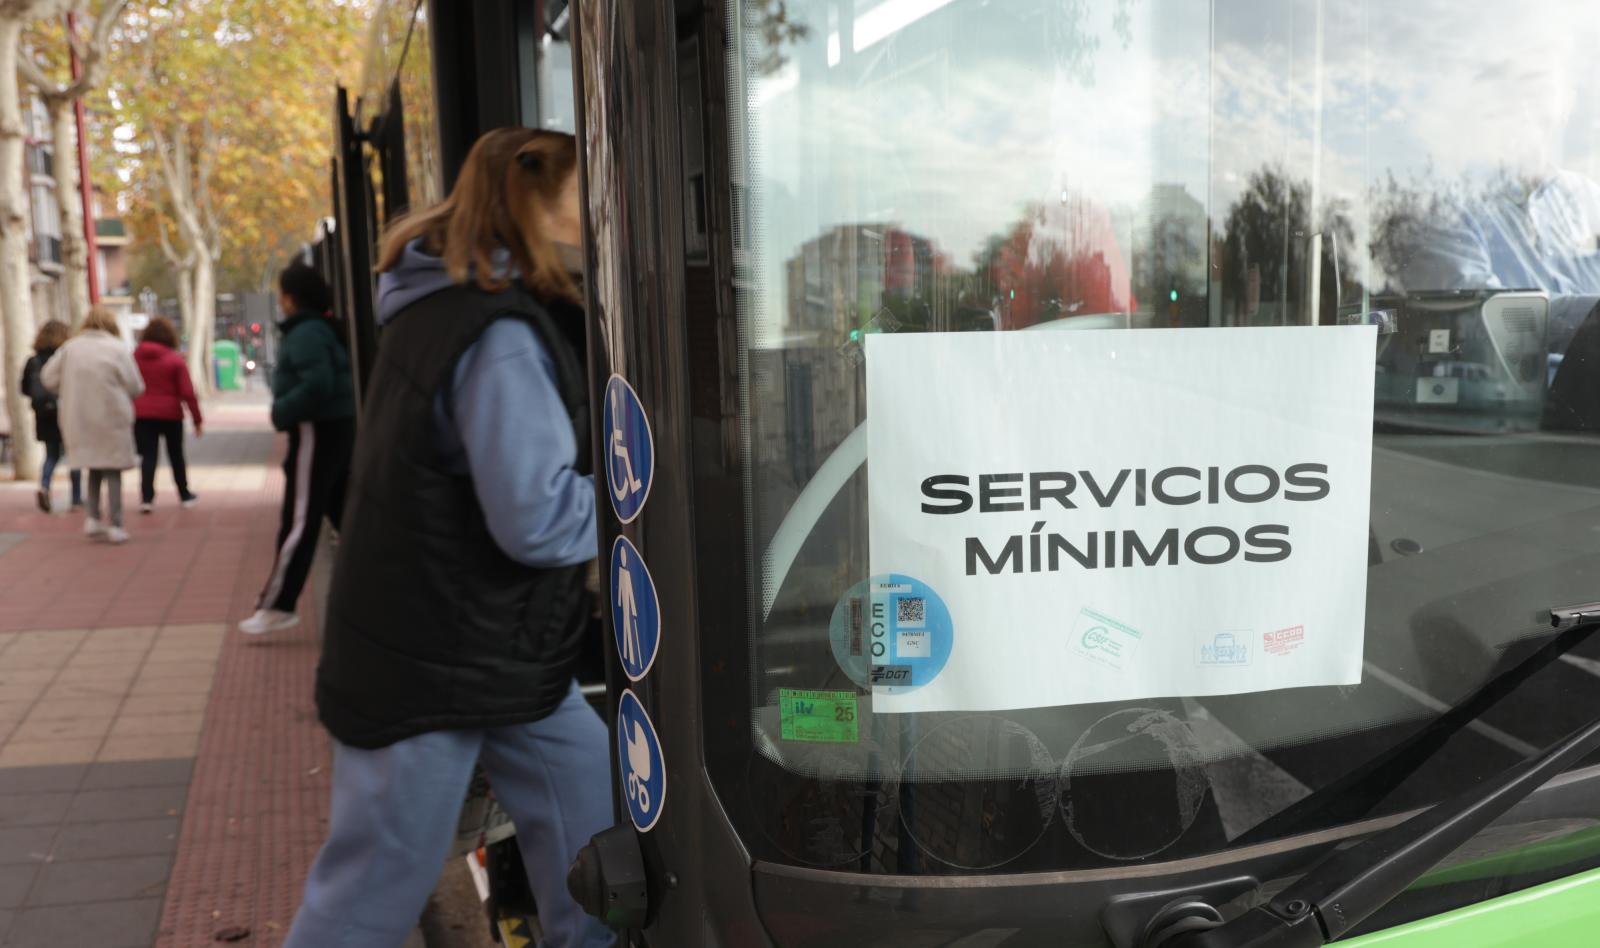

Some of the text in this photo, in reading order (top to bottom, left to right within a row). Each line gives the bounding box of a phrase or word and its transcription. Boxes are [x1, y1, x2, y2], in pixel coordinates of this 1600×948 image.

[920, 463, 1331, 515] SERVICIOS
[965, 521, 1293, 576] MÍNIMOS
[871, 603, 885, 657] ECO
[885, 670, 909, 680] DGT
[835, 706, 854, 722] 25
